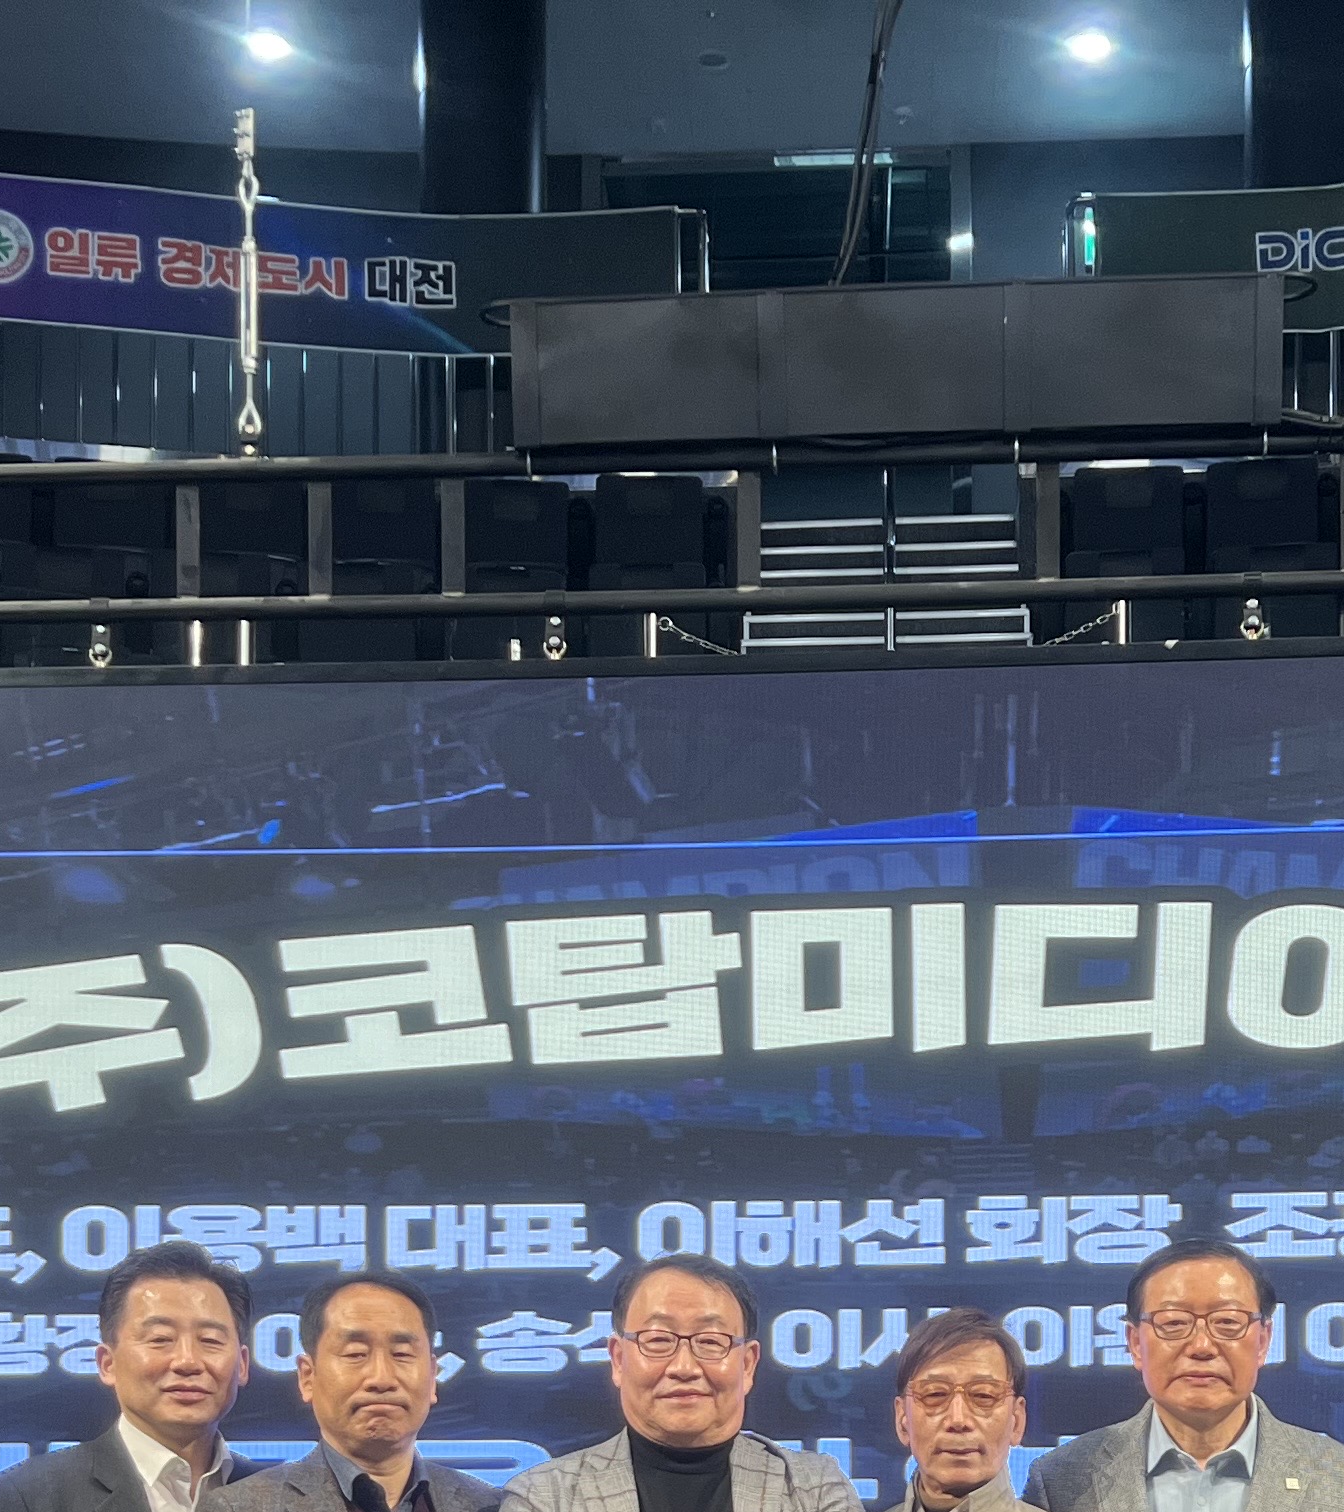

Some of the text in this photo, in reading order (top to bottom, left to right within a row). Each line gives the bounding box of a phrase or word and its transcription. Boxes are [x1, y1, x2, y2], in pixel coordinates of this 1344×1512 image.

[46, 228, 142, 282] 일류
[158, 238, 348, 300] 경제도시
[365, 257, 456, 308] 대전
[385, 1202, 622, 1283] 대표,
[638, 1197, 947, 1268] 이해선
